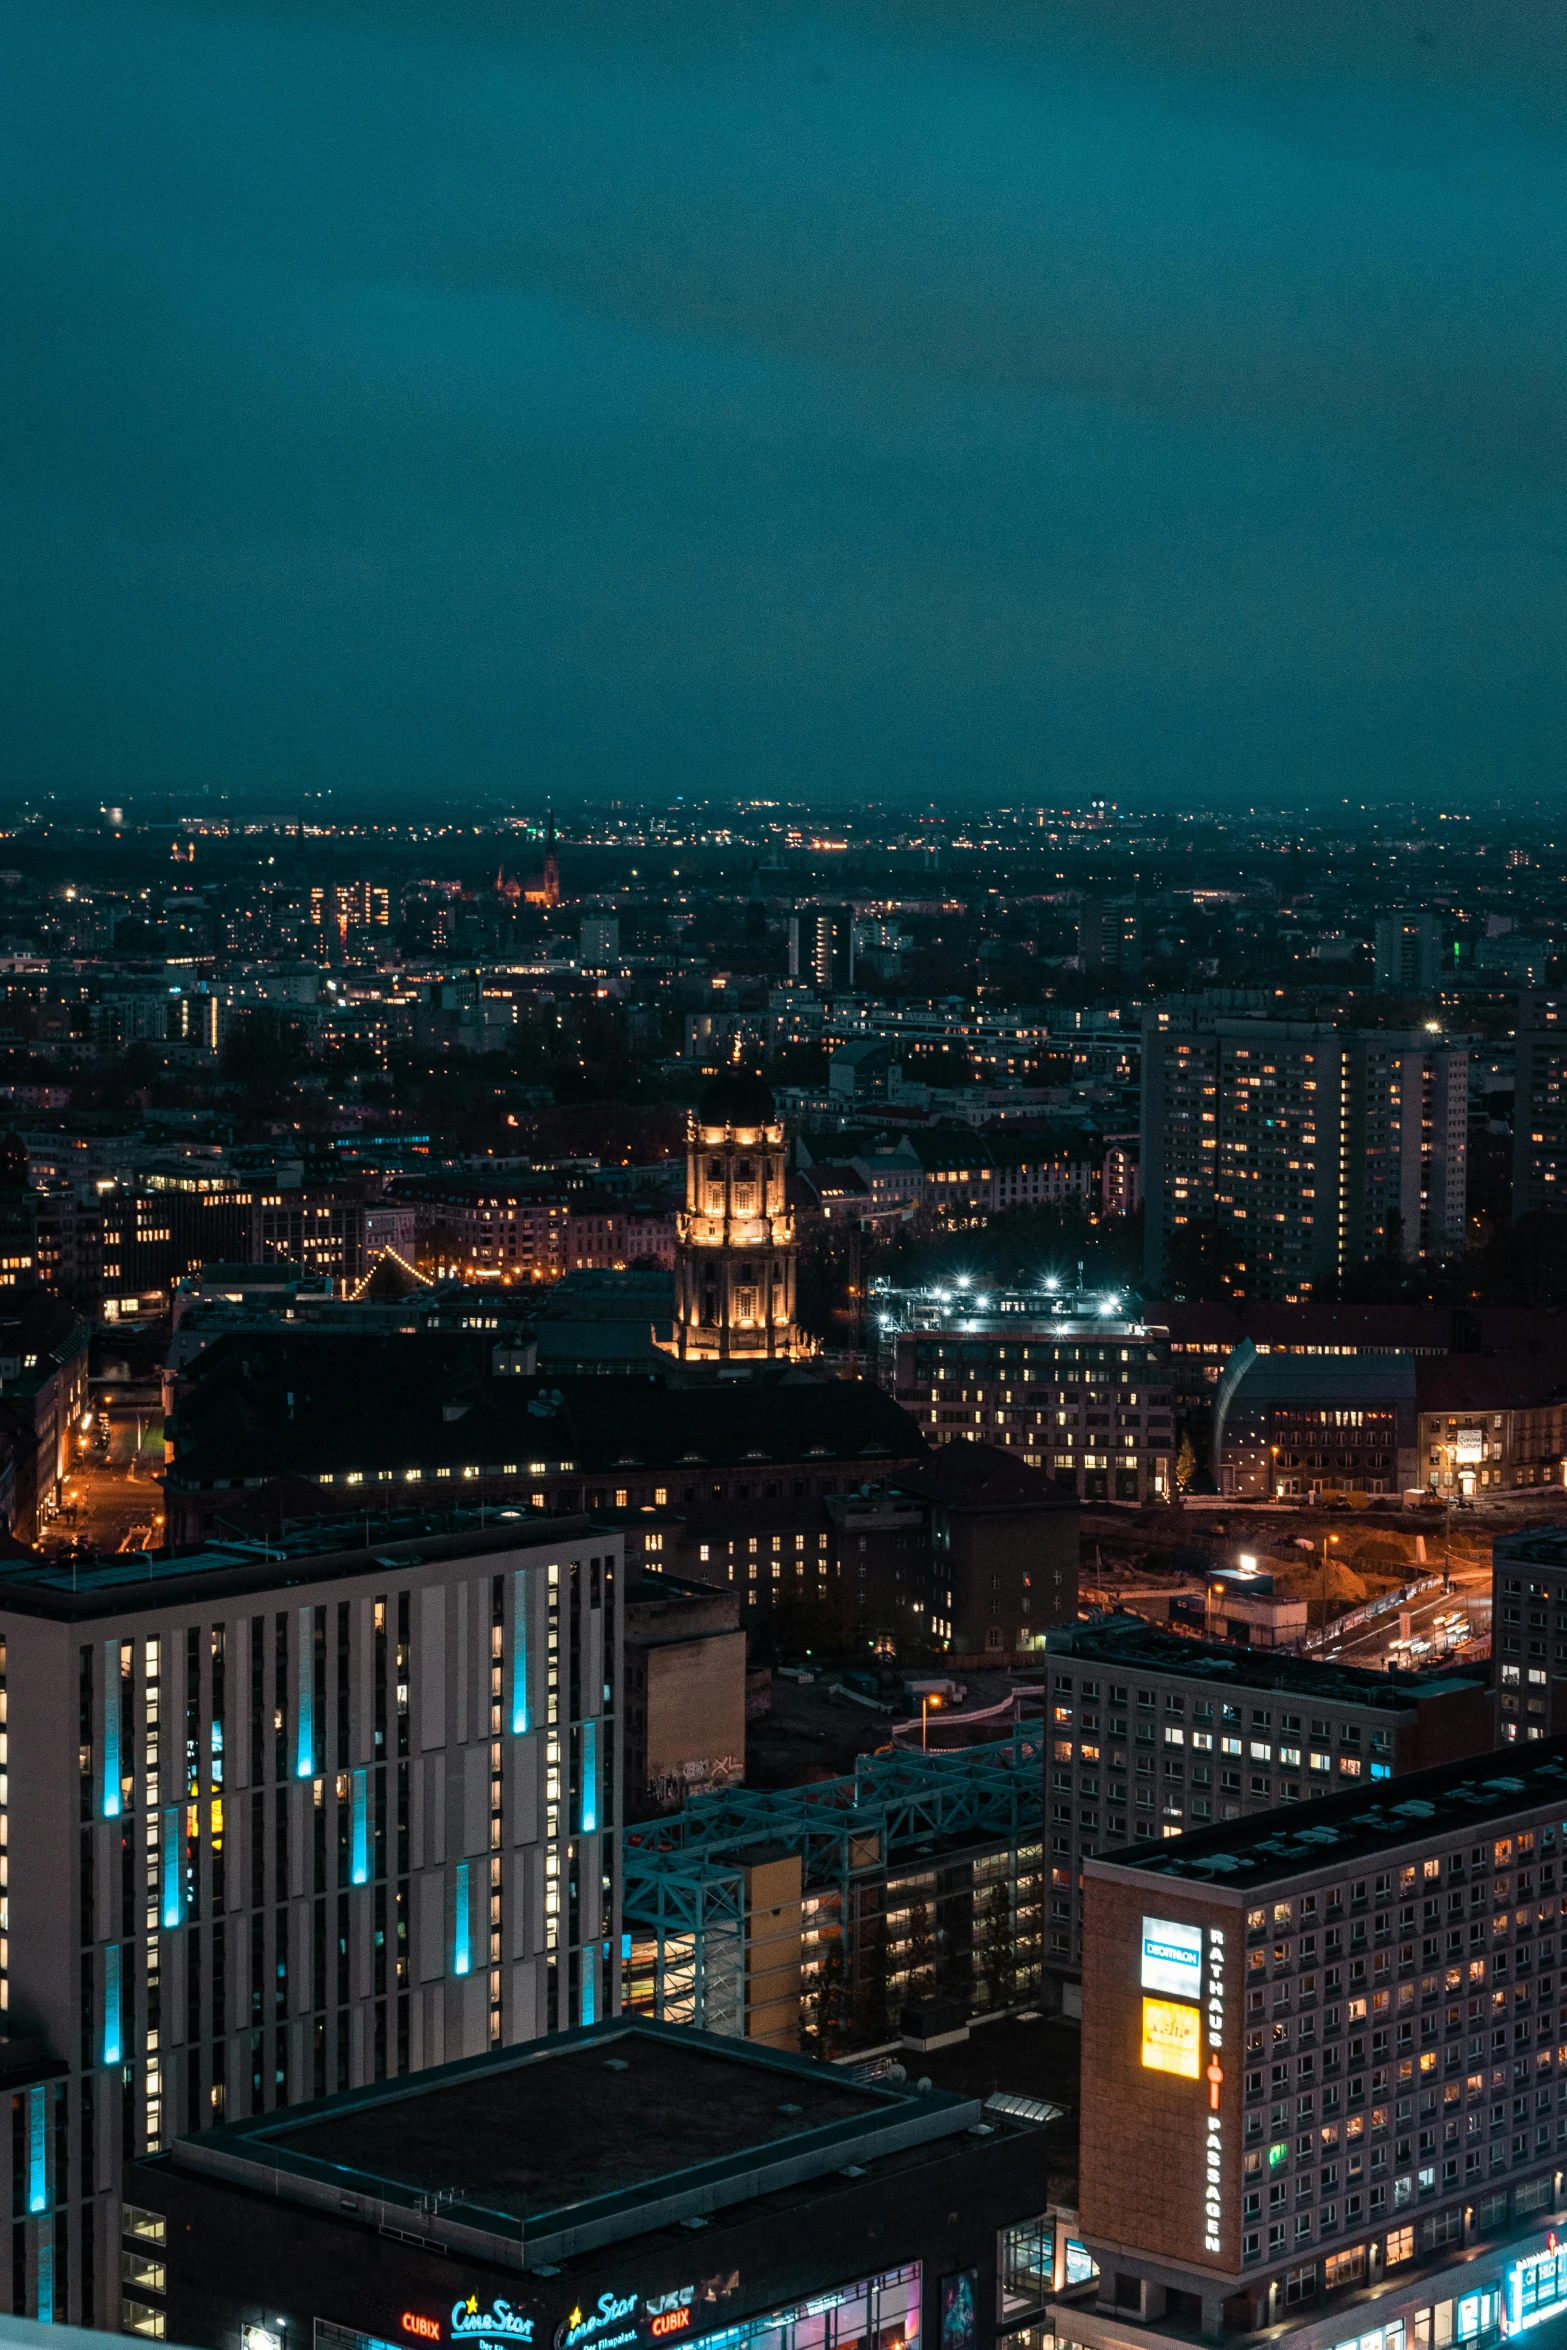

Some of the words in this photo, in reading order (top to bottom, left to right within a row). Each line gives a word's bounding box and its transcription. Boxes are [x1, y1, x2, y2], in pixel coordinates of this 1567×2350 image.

[1147, 1943, 1197, 1965] DECATHLON
[1208, 1929, 1225, 2047] RATHAUS
[1205, 2116, 1222, 2253] PASSAGEN
[402, 2312, 440, 2341] CUBIX
[451, 2297, 535, 2335] CineStar
[651, 2307, 690, 2337] CUBIX
